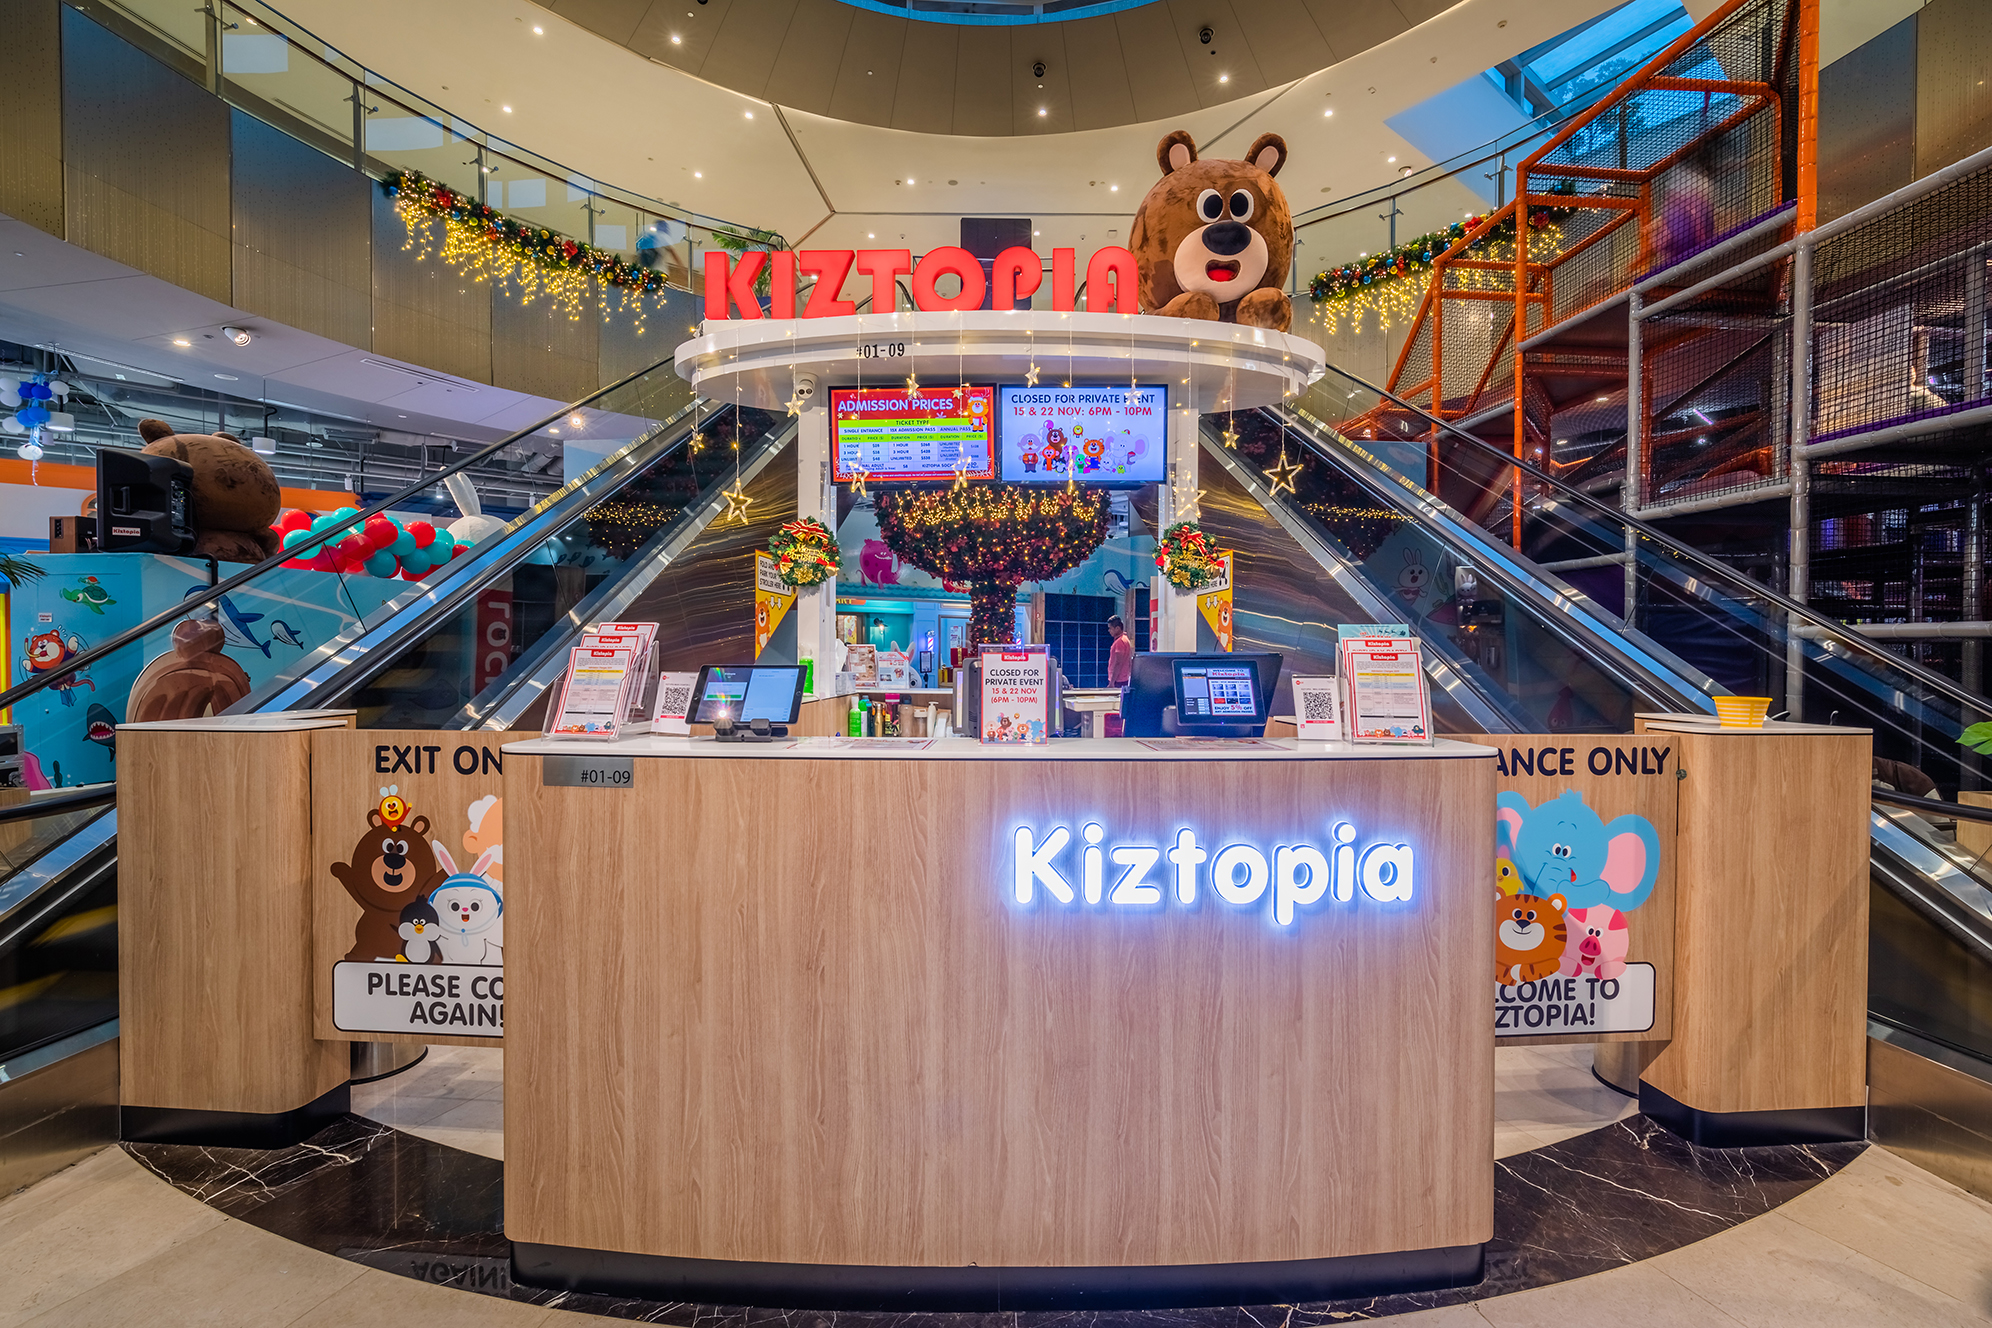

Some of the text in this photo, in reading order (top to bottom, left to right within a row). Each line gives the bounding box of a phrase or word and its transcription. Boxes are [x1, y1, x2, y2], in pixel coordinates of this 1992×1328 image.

[704, 246, 1139, 320] KIZTOPIA
[856, 342, 905, 358] #01-09
[837, 398, 954, 412] ADMISSION PRICES
[1011, 394, 1156, 404] CLOSED FOR PRIVATE ENT
[1013, 406, 1026, 416] 15
[1029, 406, 1037, 416] &
[1040, 406, 1054, 416] 22
[1058, 406, 1085, 416] NOV:
[1088, 406, 1112, 416] 6PM
[1124, 406, 1153, 416] 10PM
[989, 669, 1039, 677] CLOSED FOR
[985, 678, 1044, 686] PRIVATE EVENT
[992, 687, 1038, 695] 15 & 22 NOV
[990, 696, 1010, 704] (6PM
[1016, 696, 1038, 704] 10PM)
[375, 745, 441, 774] EXIT
[1587, 746, 1671, 776] ONLY
[581, 769, 631, 784] #01-09
[1014, 821, 1414, 926] Kiztopia
[368, 972, 461, 999] PLEASE
[1586, 978, 1620, 1001] TO
[409, 1001, 504, 1028] AGAIN!
[1495, 1002, 1595, 1029] ZTOPIA!
